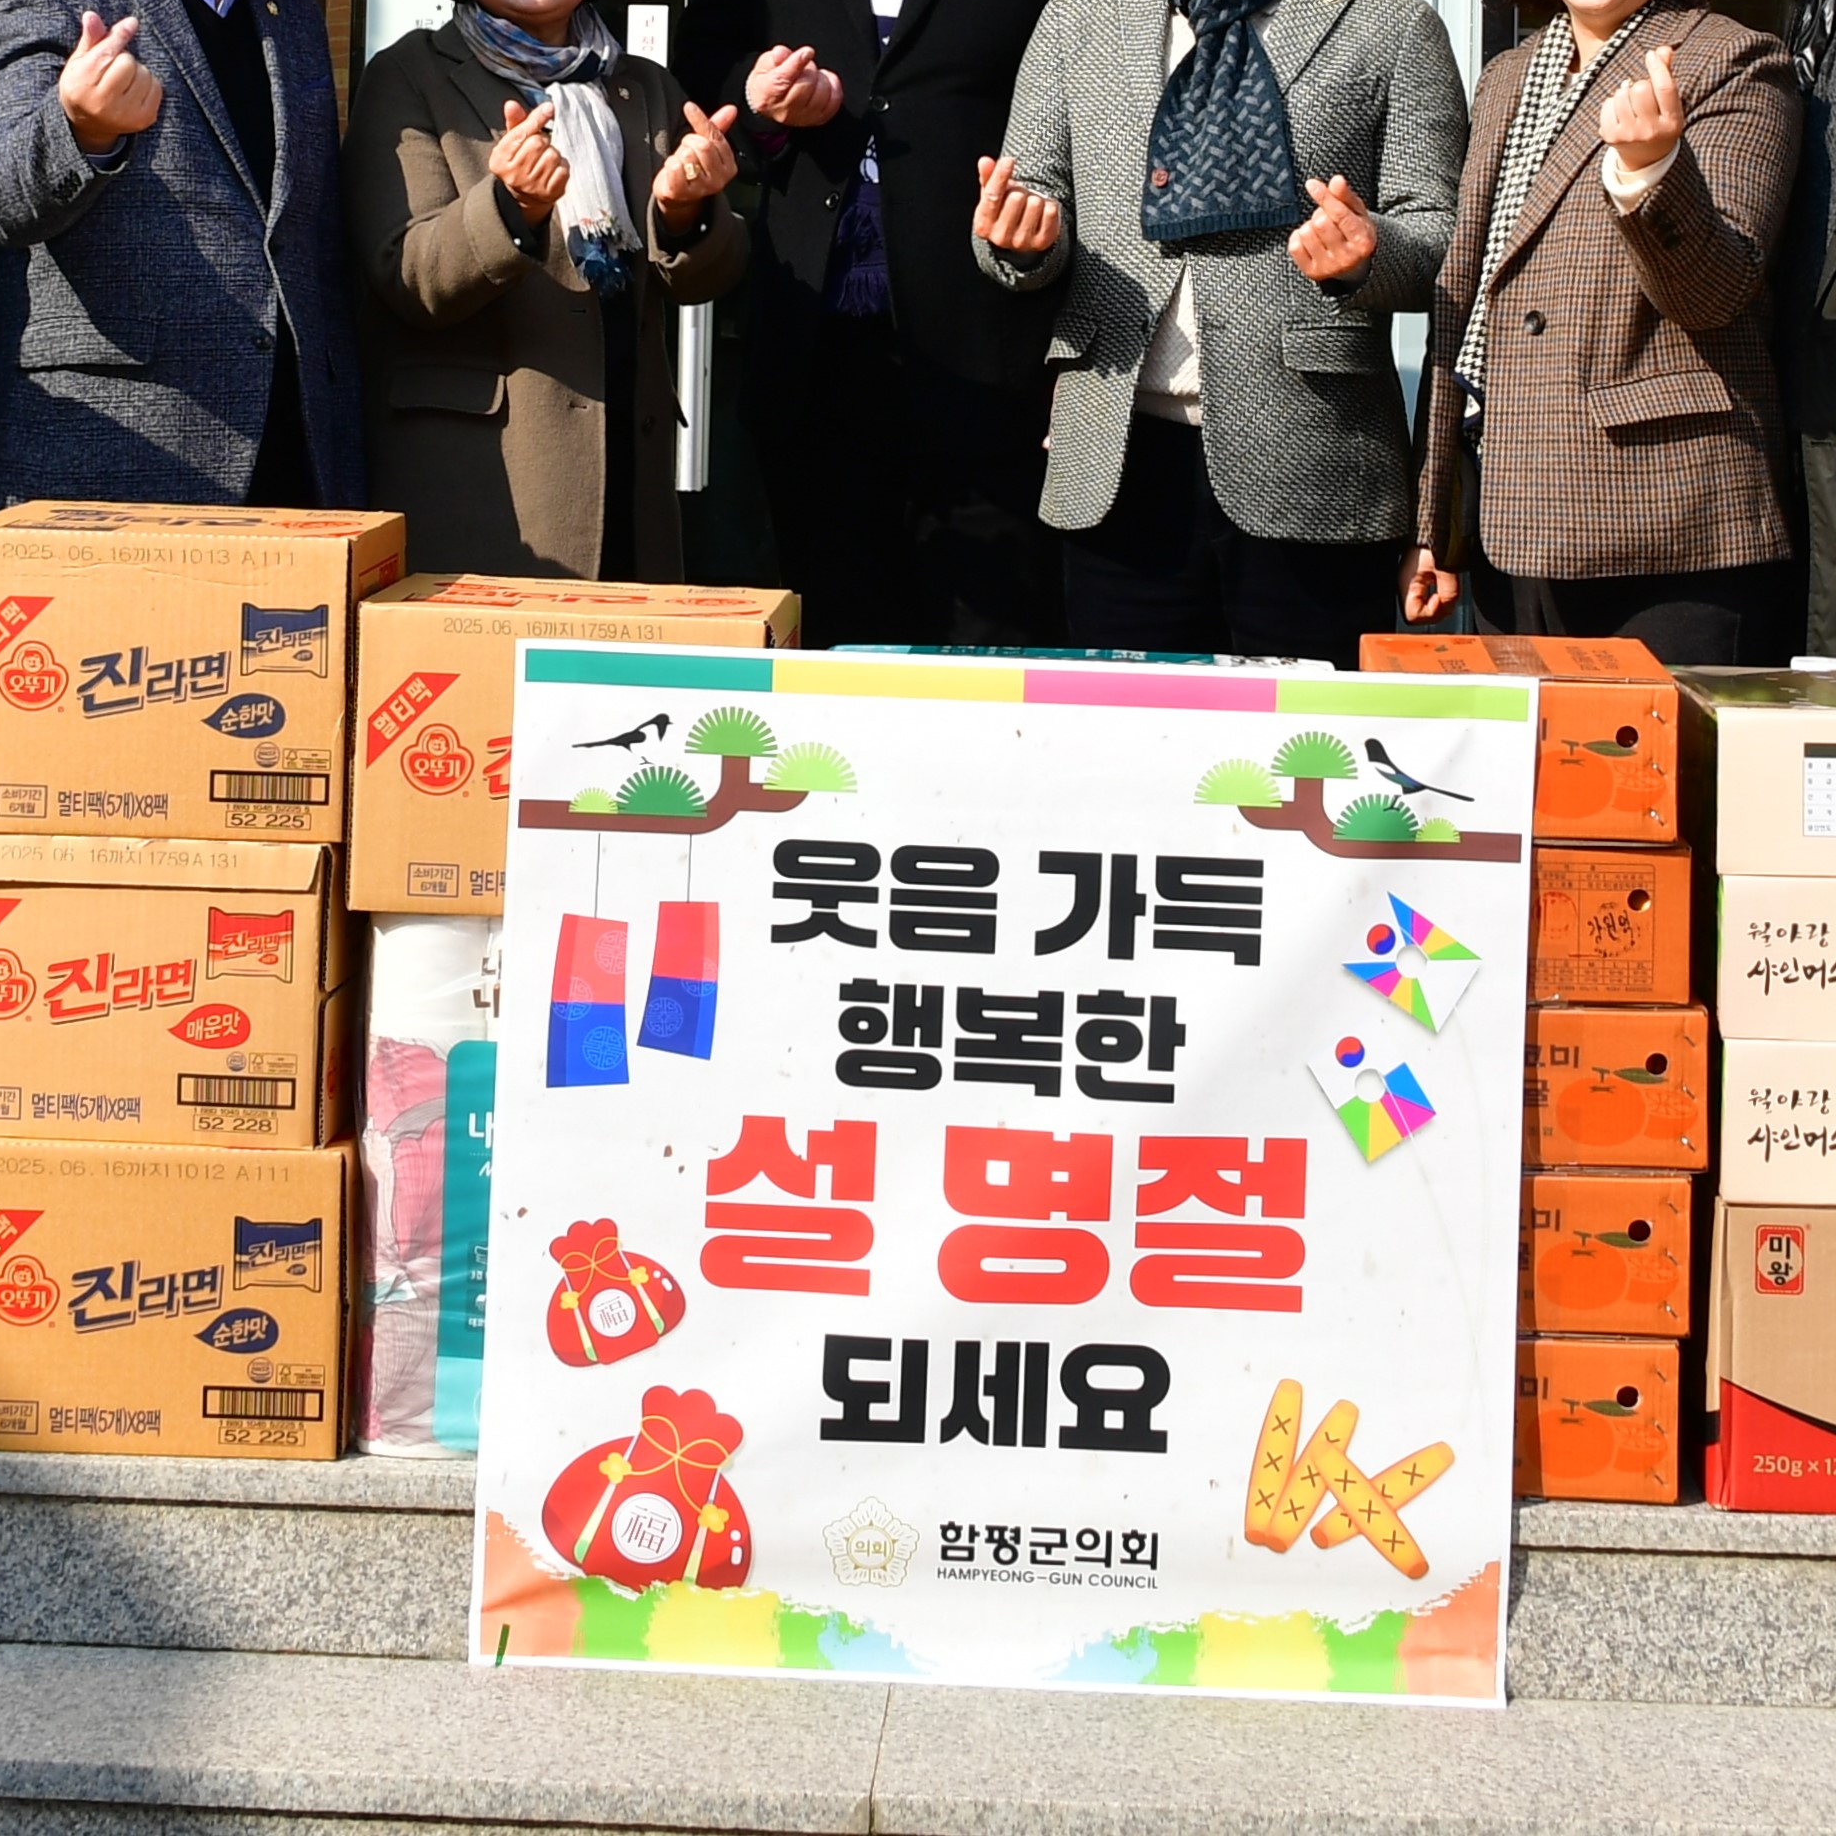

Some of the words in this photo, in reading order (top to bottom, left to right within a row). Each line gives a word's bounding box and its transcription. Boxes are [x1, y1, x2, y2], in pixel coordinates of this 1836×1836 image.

[255, 627, 313, 654] 진라면
[8, 675, 56, 695] 오뚜기
[77, 645, 232, 718] 진라면
[219, 700, 275, 734] 순한맛
[373, 677, 434, 738] 멀티팩
[413, 757, 462, 779] 오뚜기
[1, 788, 42, 801] 소비기간
[8, 801, 36, 813] 6개월
[230, 813, 257, 826] 52
[266, 814, 304, 828] 225
[412, 867, 454, 880] 소비기간
[420, 881, 448, 893] 6개월
[770, 838, 1000, 954] 웃음
[1034, 850, 1264, 967] 가득
[42, 952, 197, 1024] 진라면
[186, 1009, 241, 1041] 매운맛
[835, 977, 1186, 1104] 행복한
[199, 1117, 224, 1130] 52
[233, 1118, 272, 1132] 228
[699, 1114, 878, 1297] 설
[937, 1124, 1308, 1313] 명절
[247, 1240, 307, 1268] 진라면
[1768, 1235, 1794, 1286] 미왕
[67, 1259, 224, 1334] 진라면
[596, 1296, 629, 1329] 福
[212, 1315, 269, 1349] 순한맛
[819, 1333, 1171, 1454] 되세요
[0, 1417, 27, 1430] 6개월
[224, 1430, 250, 1442] 52
[259, 1430, 298, 1444] 225
[1753, 1454, 1803, 1478] 250g
[621, 1505, 672, 1555] 福
[854, 1539, 888, 1558] 의회
[939, 1521, 1159, 1571] 함평군의회
[1088, 1573, 1158, 1589] COUNCIL
